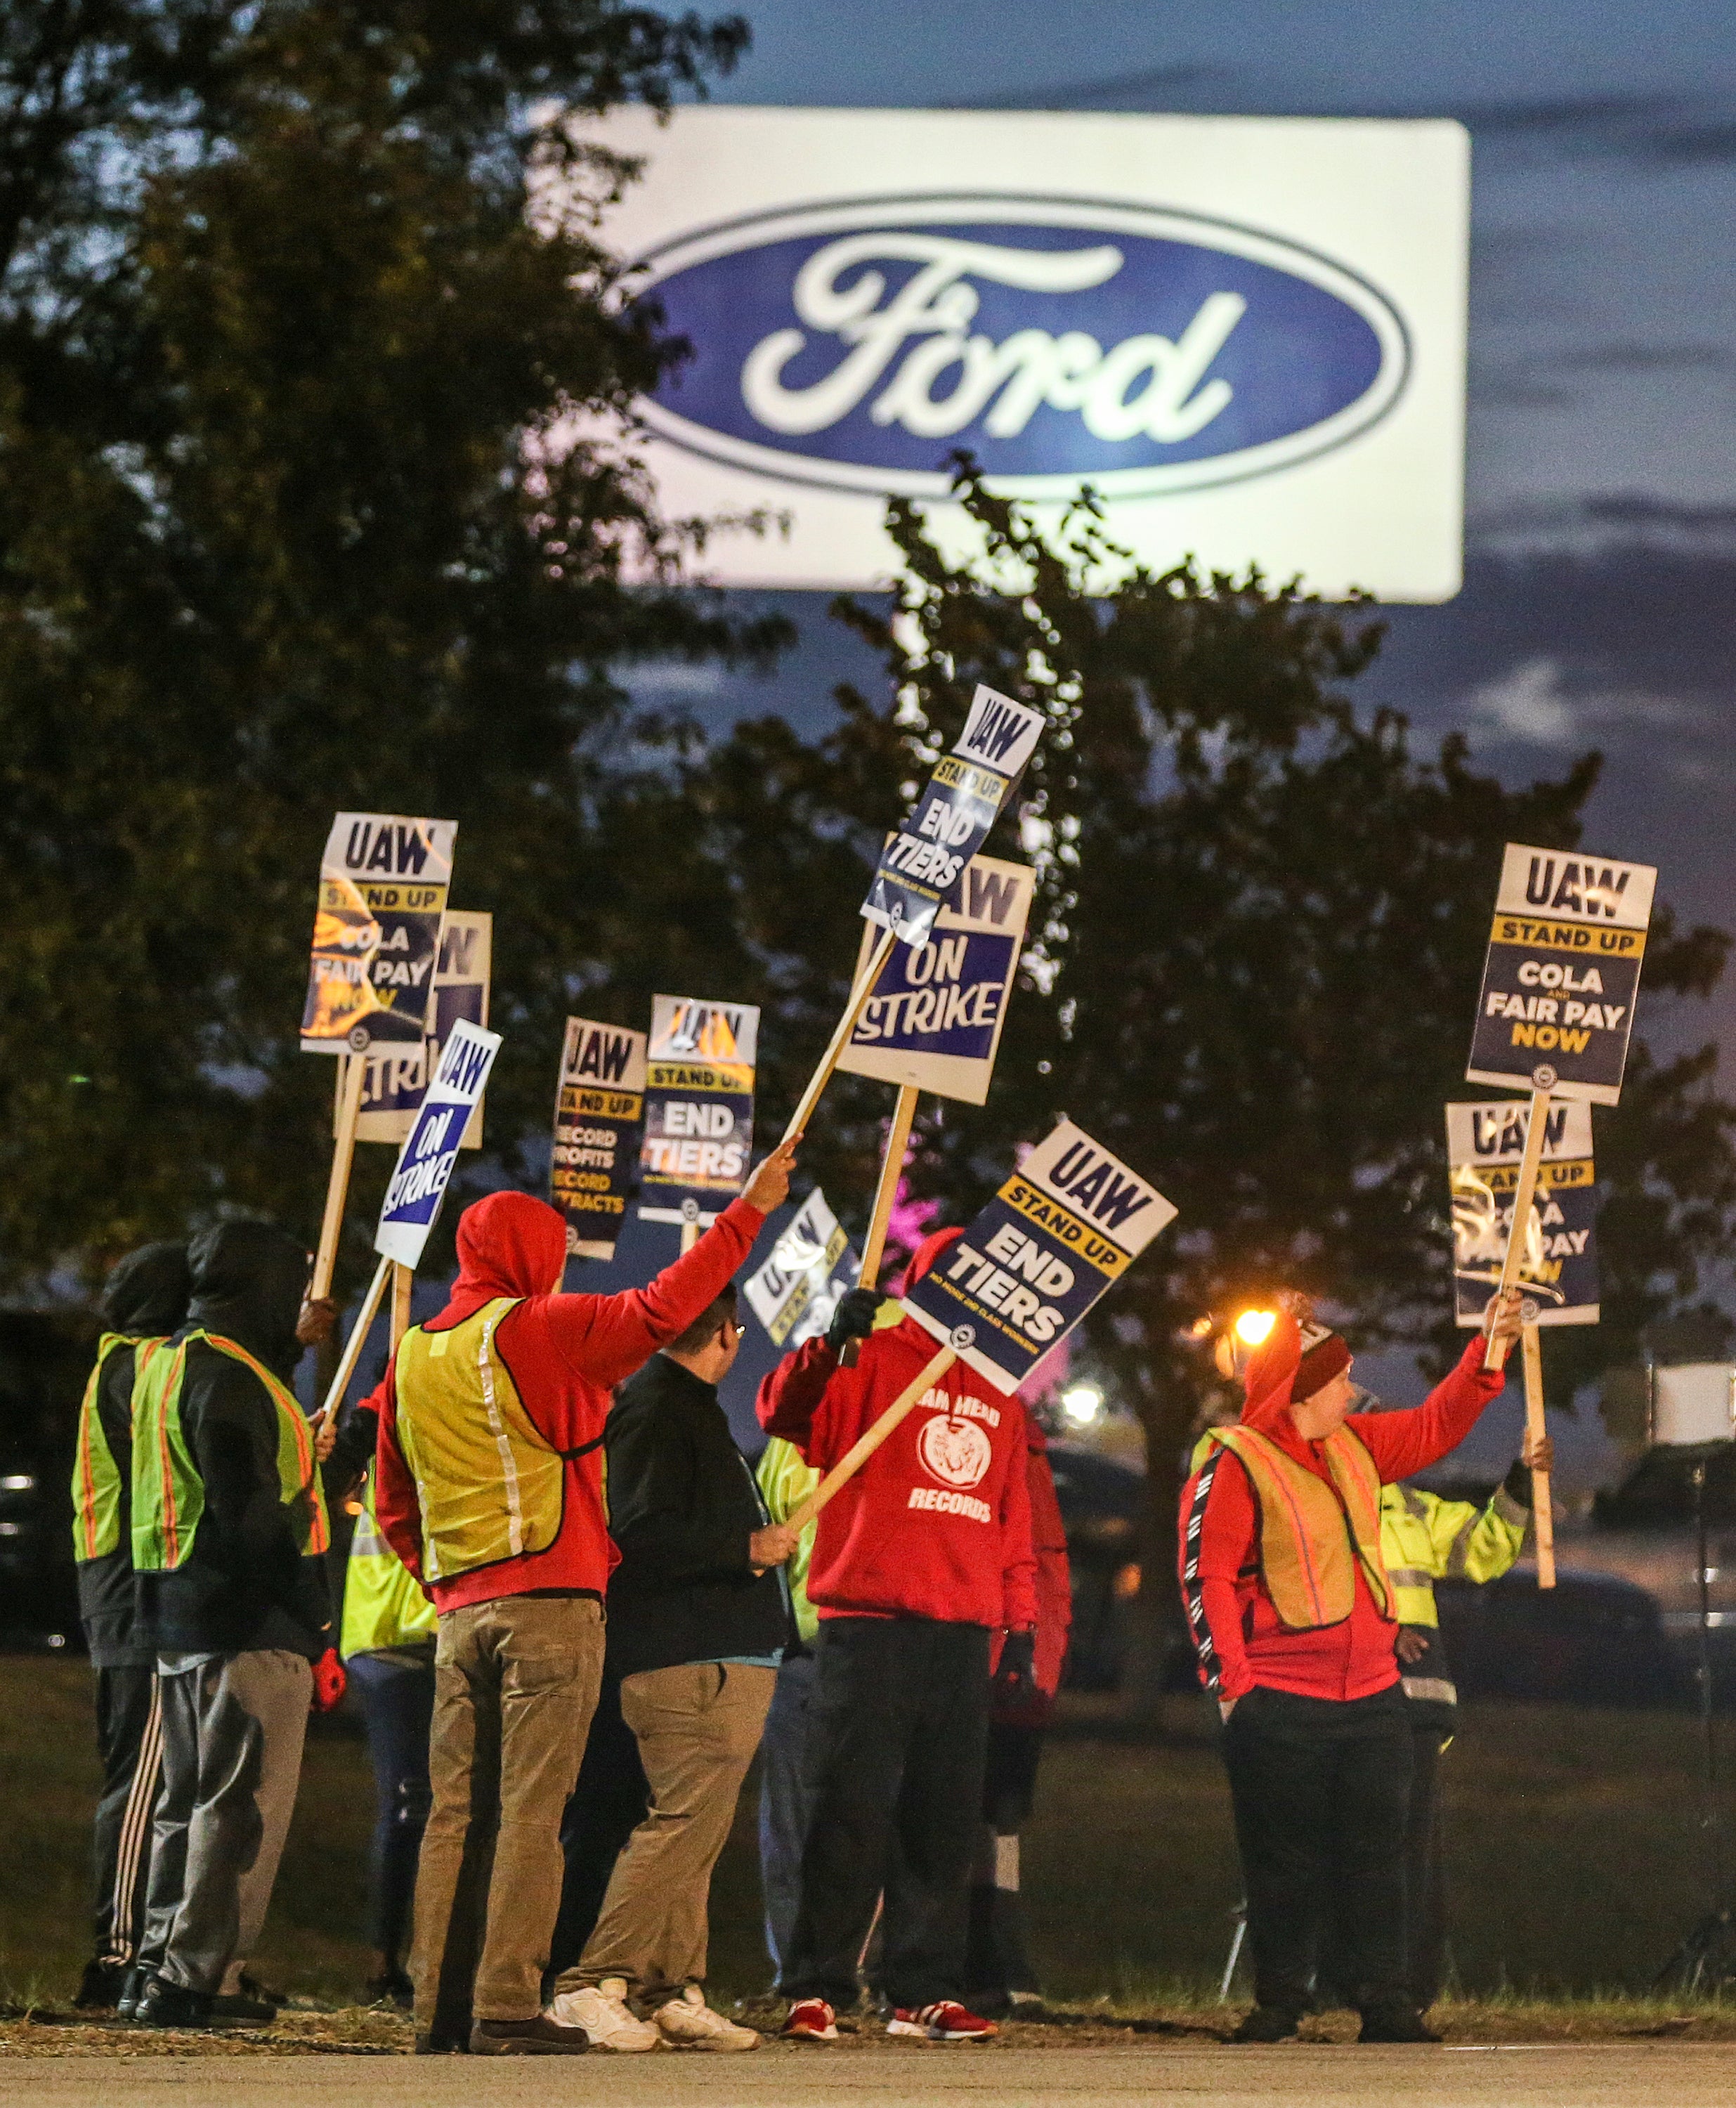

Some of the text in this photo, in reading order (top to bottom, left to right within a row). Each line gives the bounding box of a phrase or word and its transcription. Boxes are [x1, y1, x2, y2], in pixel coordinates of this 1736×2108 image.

[740, 233, 1248, 443] Ford
[345, 819, 436, 875] UAW
[919, 798, 975, 847] END
[887, 833, 965, 889] TIERS
[407, 890, 438, 907] UP
[1525, 856, 1631, 918] UAW
[905, 935, 969, 985] ON
[1502, 921, 1636, 951] STAND UP
[373, 954, 433, 987] PAY
[1518, 960, 1604, 995] COLA
[854, 982, 1005, 1041] STRIKE
[1486, 991, 1626, 1031] FAIR PAY
[1511, 1022, 1592, 1055] NOW
[654, 1067, 714, 1086] STAND
[415, 1107, 455, 1159] ON
[663, 1100, 734, 1138] END
[647, 1138, 745, 1178] TIERS
[1552, 1166, 1584, 1183] UP
[384, 1150, 457, 1216] STRIKE
[1048, 1140, 1154, 1231] UAW
[1008, 1185, 1118, 1266] STAND UP
[985, 1222, 1076, 1298] END
[947, 1242, 1066, 1341] TIERS
[917, 1388, 950, 1412] AM
[908, 1487, 991, 1523] RECORDS
